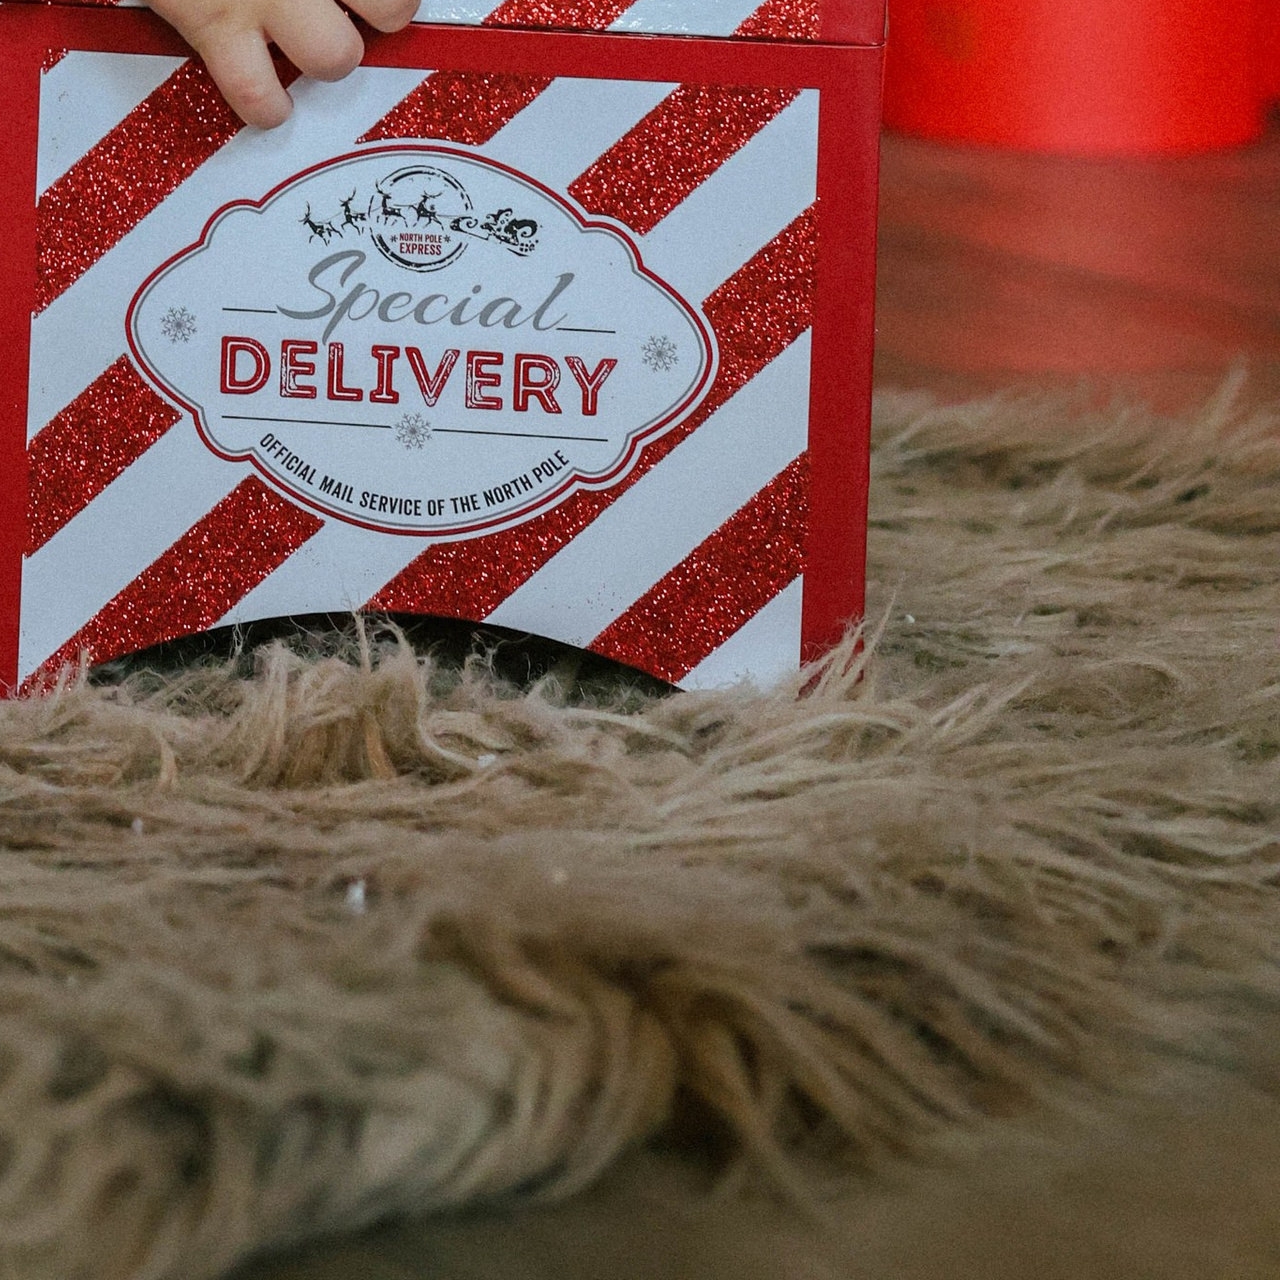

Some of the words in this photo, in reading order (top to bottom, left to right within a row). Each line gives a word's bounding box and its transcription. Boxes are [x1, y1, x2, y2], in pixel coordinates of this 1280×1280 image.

[399, 233, 423, 243] NORTH
[425, 234, 442, 243] POLE
[399, 242, 442, 255] EXPRESS
[276, 250, 576, 345] Special
[220, 336, 619, 416] DELIVERY
[259, 433, 317, 485] OFFICIAL
[319, 474, 354, 504] MAIL
[359, 491, 422, 516] SERVICE
[427, 499, 445, 516] OF
[450, 494, 481, 514] THE
[484, 474, 535, 506] NORTH
[532, 449, 570, 484] POLE
